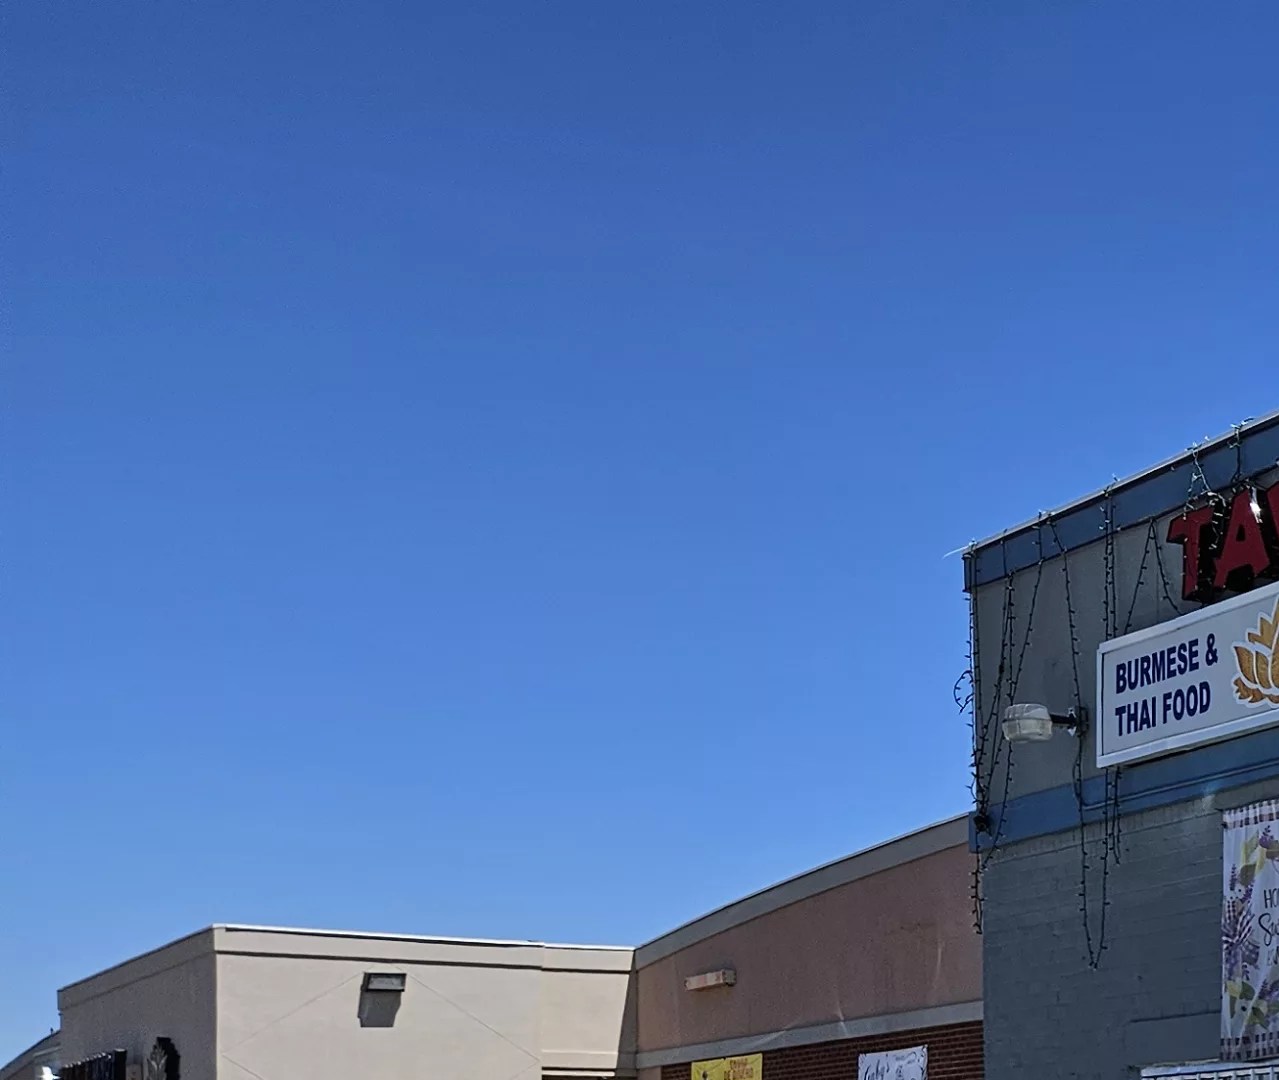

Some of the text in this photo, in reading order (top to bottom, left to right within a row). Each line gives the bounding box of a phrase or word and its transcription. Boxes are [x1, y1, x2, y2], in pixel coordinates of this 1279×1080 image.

[1115, 633, 1219, 694] BURMESE &
[1115, 681, 1211, 737] THAI FOOD
